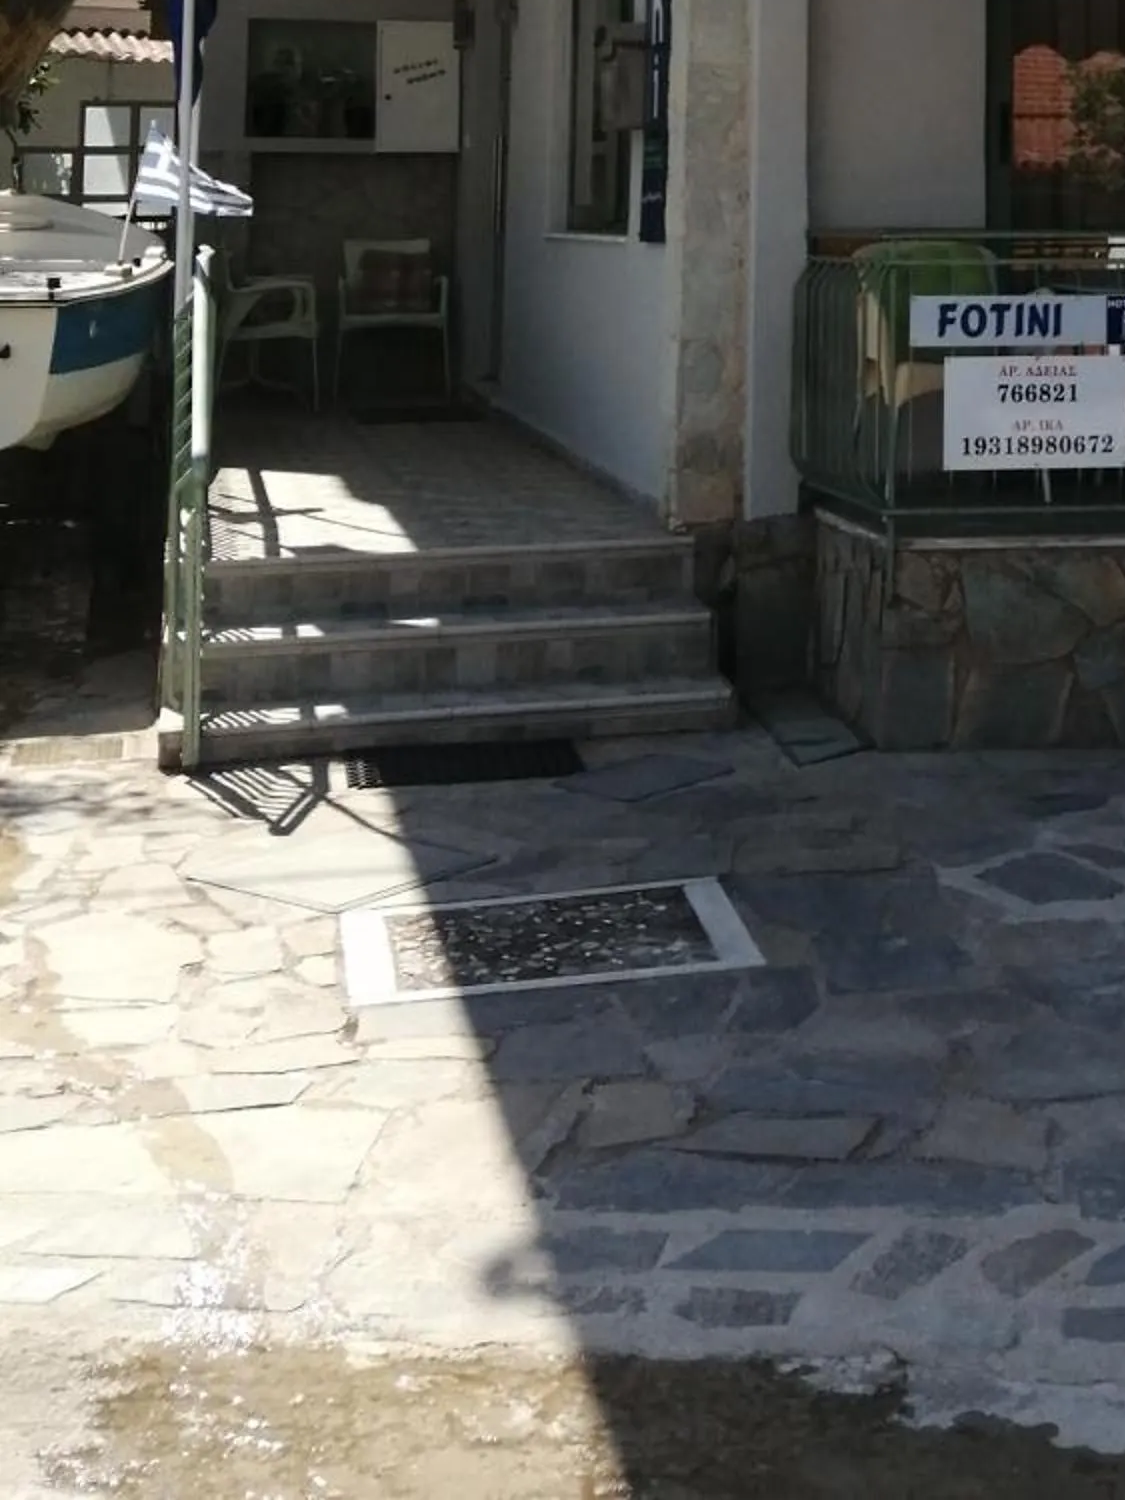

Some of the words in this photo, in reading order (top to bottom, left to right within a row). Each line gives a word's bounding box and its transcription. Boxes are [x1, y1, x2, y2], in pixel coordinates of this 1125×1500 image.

[937, 303, 1063, 338] FOTINI
[997, 383, 1078, 403] 766821
[962, 435, 1114, 455] 19318980672
